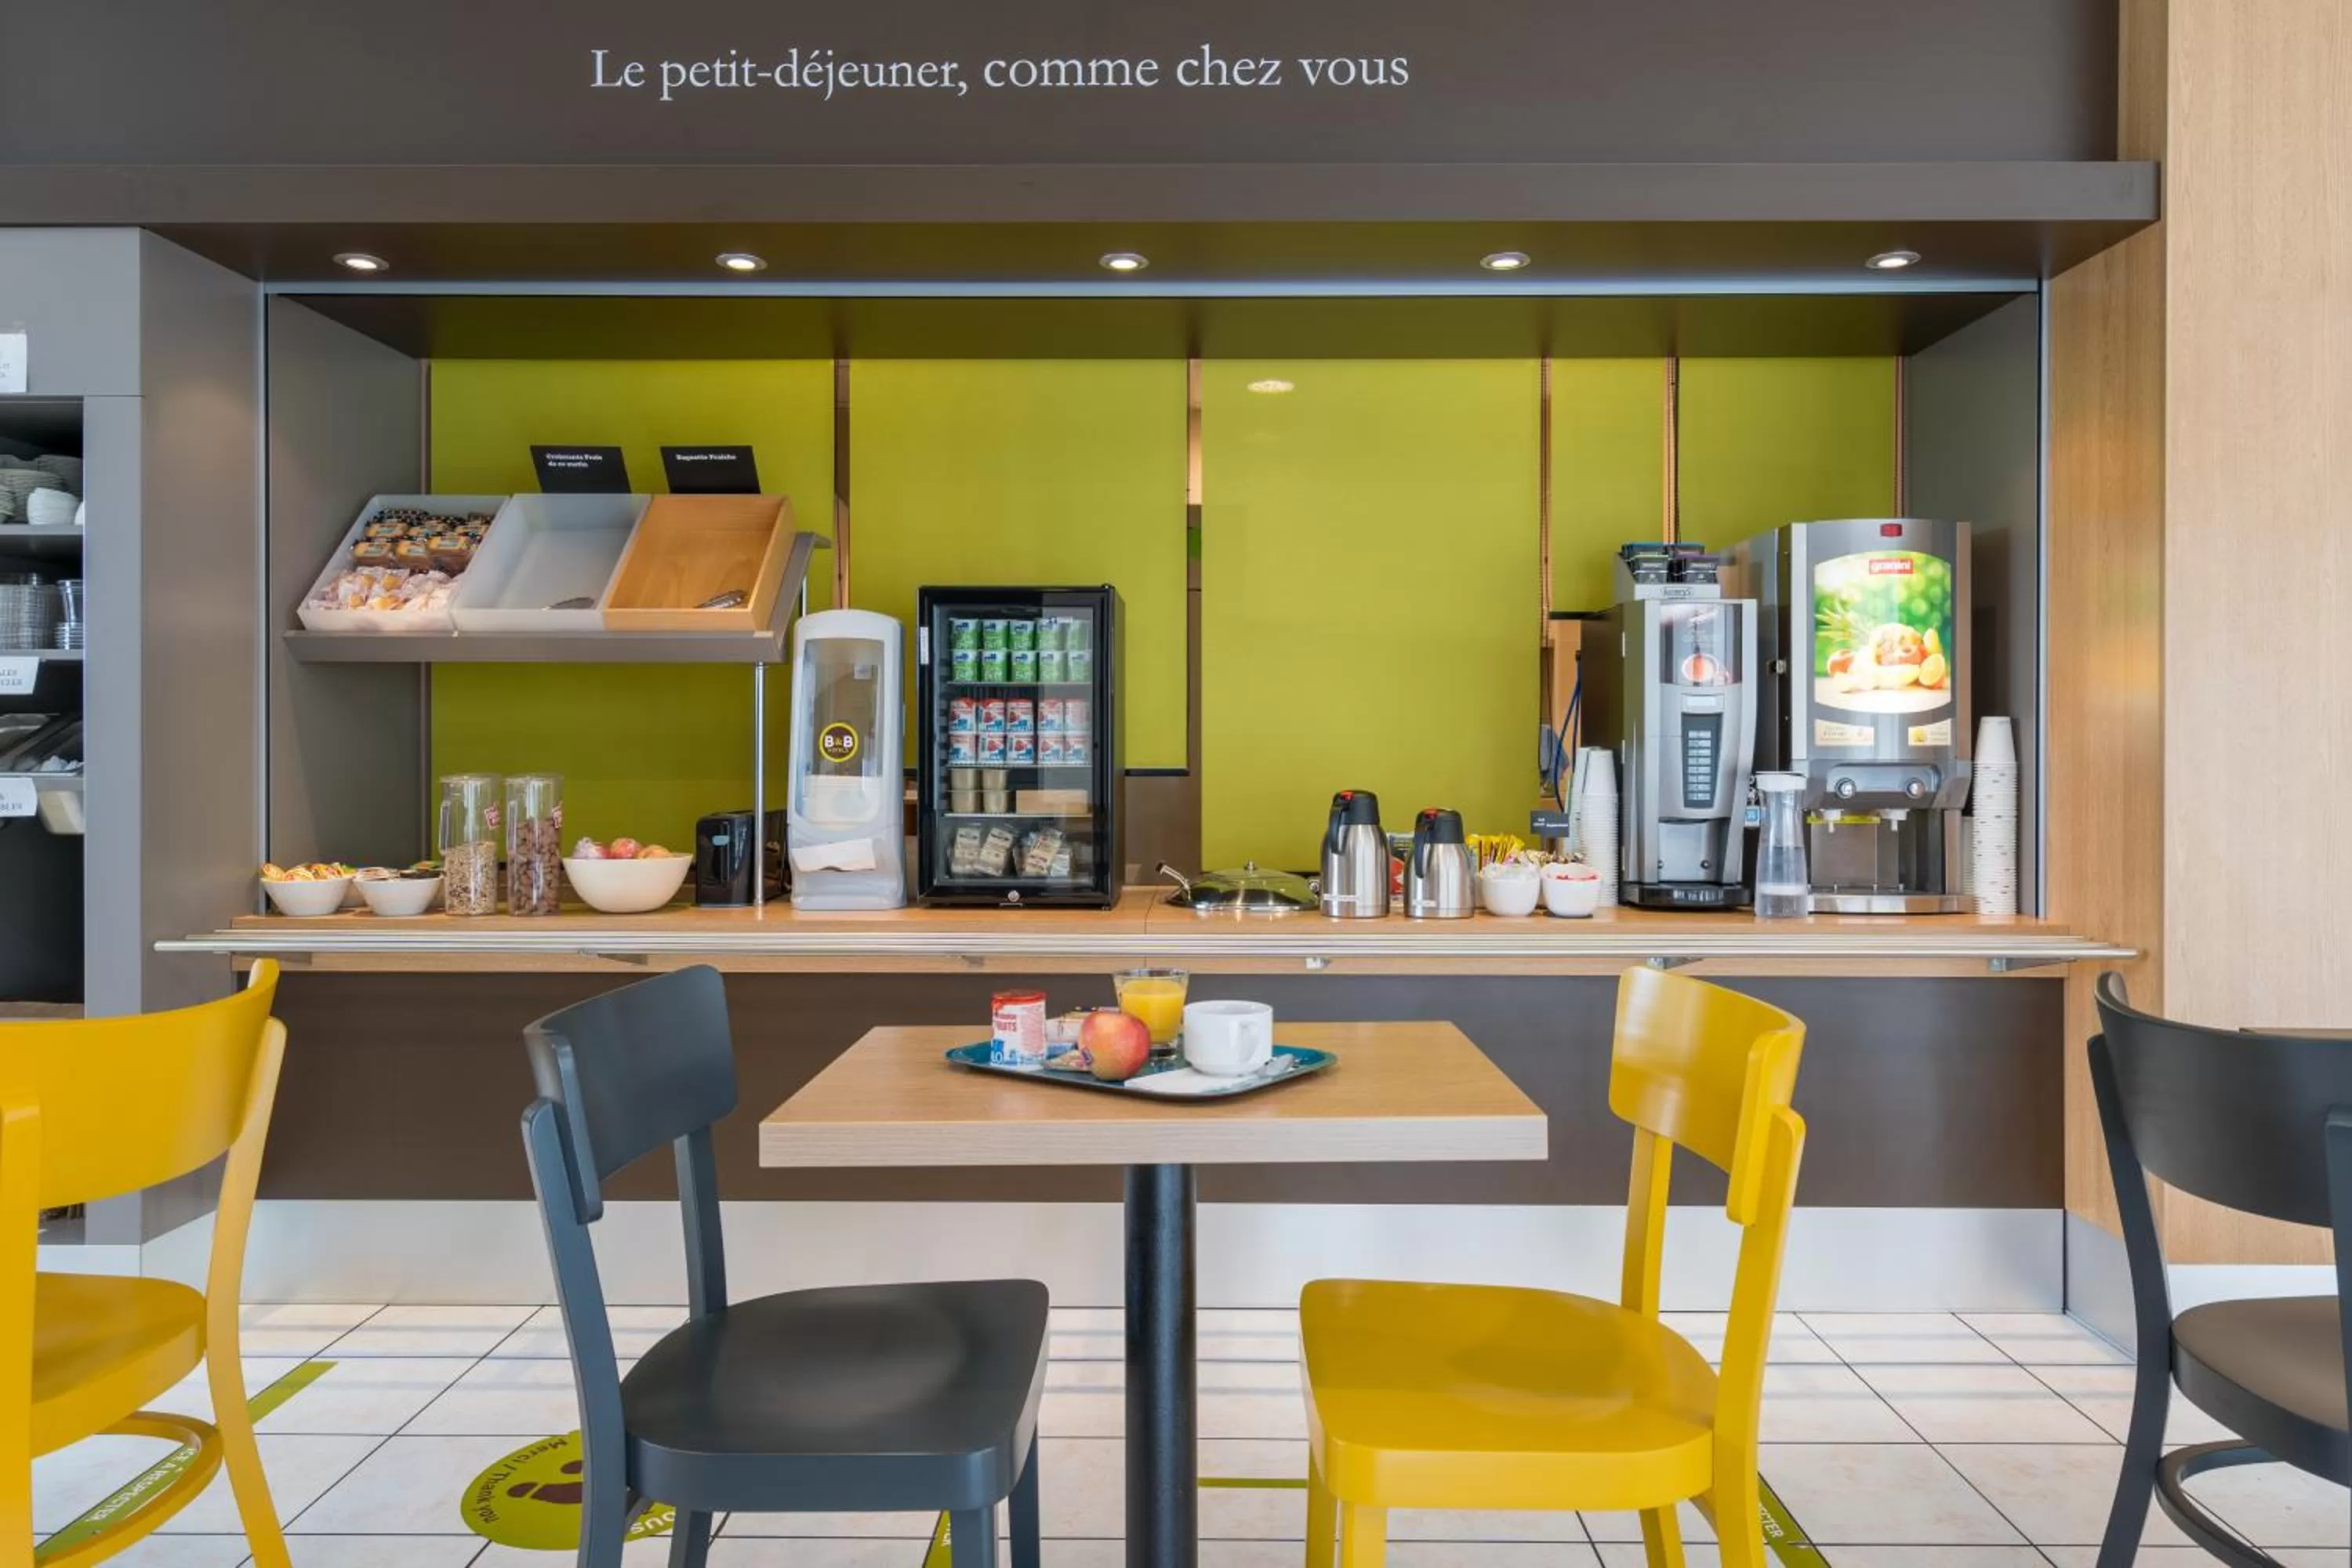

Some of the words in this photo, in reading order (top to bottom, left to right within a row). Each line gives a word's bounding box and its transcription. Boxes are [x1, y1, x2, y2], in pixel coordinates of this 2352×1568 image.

[590, 49, 645, 88] Le
[659, 49, 968, 101] petit-déjeuner,
[984, 59, 1159, 88] comme
[1176, 44, 1282, 87] chez
[1298, 57, 1409, 86] vous
[513, 1438, 568, 1465] Merci
[476, 1471, 510, 1504] Thank
[630, 1512, 676, 1534] OUS
